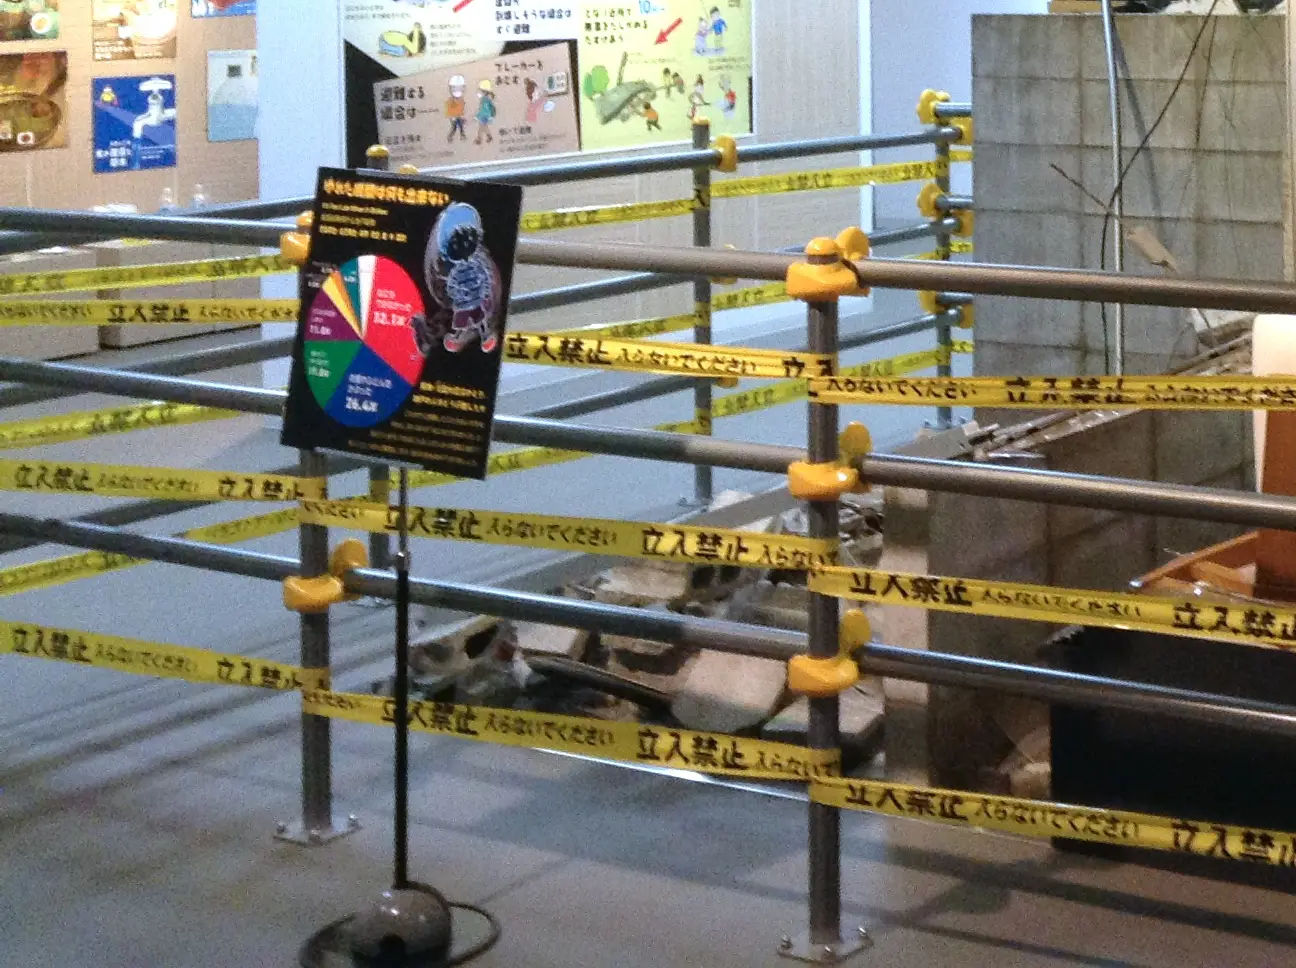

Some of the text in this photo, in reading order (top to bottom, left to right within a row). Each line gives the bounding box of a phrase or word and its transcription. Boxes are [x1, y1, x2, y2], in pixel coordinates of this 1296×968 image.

[506, 332, 612, 365] 立入禁止
[641, 527, 749, 562] 立入禁止
[849, 572, 973, 607] 立入禁止
[637, 730, 750, 770] 立入禁止
[845, 783, 969, 821] 立入禁止
